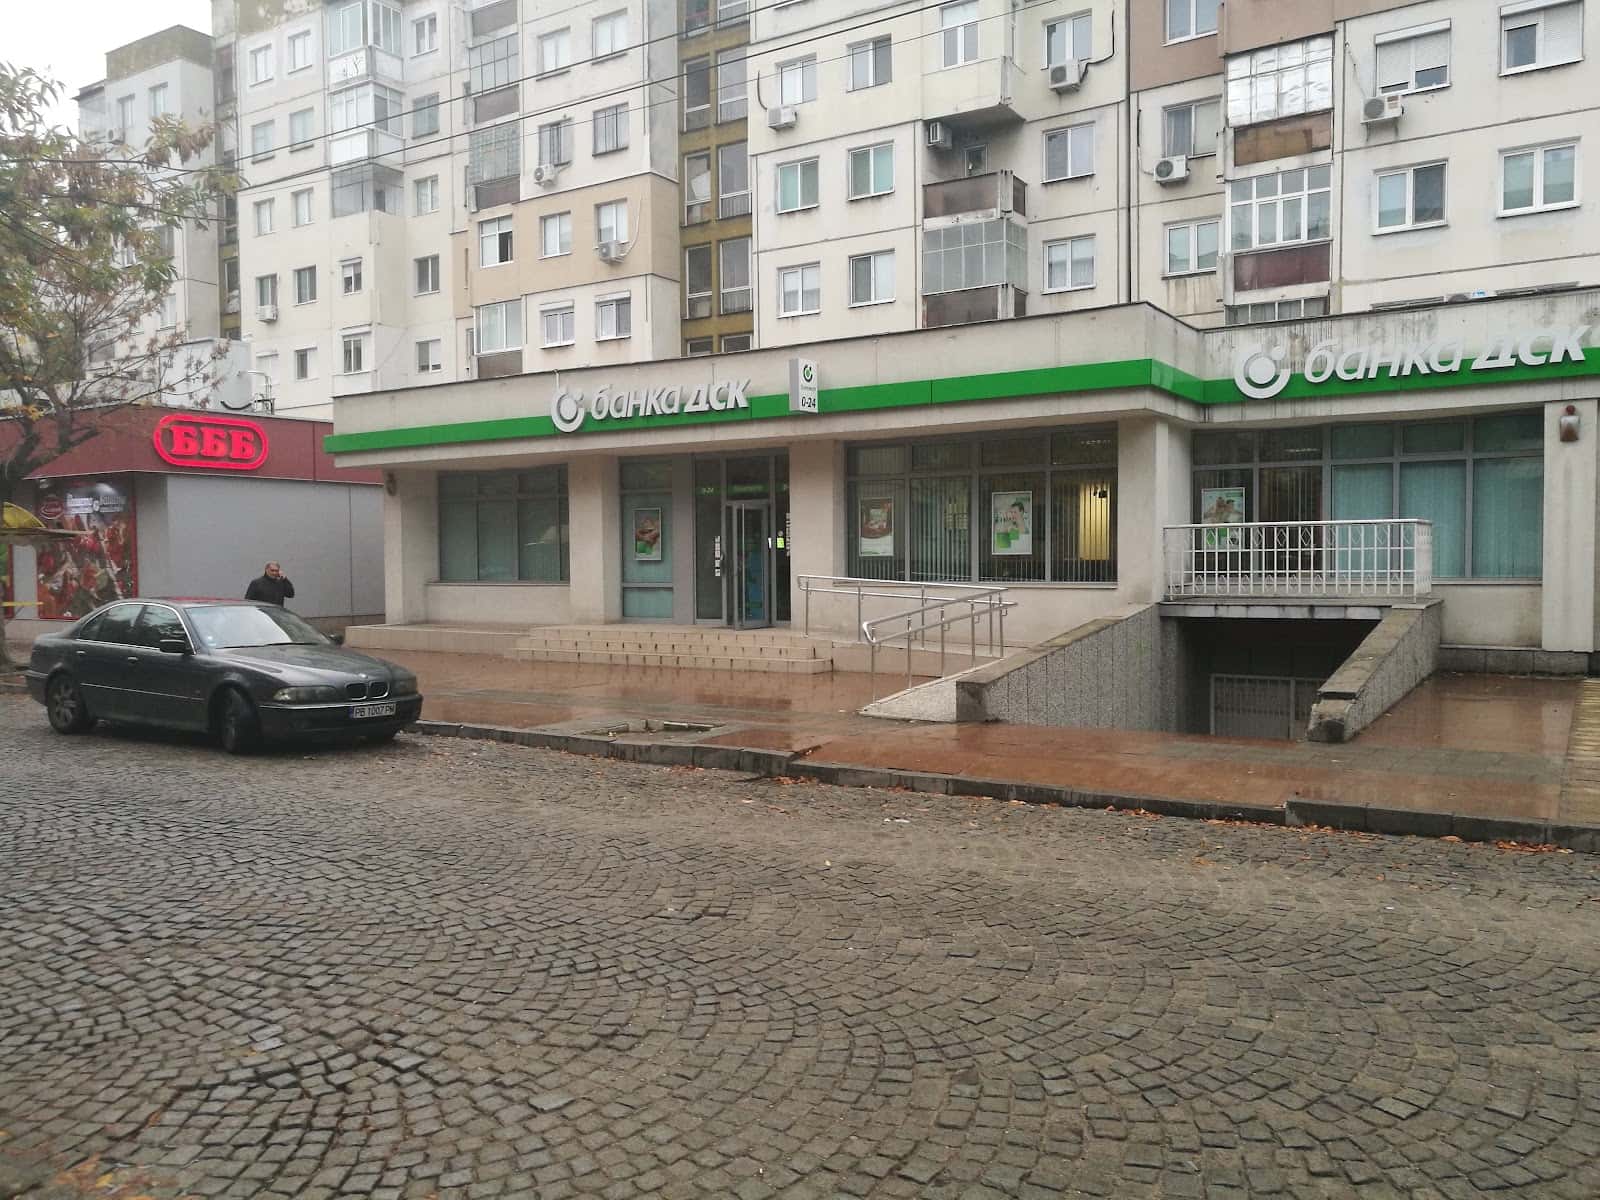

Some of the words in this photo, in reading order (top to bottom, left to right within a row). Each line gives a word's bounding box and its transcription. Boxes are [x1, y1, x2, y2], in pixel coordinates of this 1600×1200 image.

[1304, 336, 1463, 383] банка
[1471, 325, 1591, 370] ДСК
[591, 384, 683, 420] банка
[684, 379, 751, 413] ДСК
[801, 396, 816, 408] 0-24
[170, 425, 256, 460] БББ
